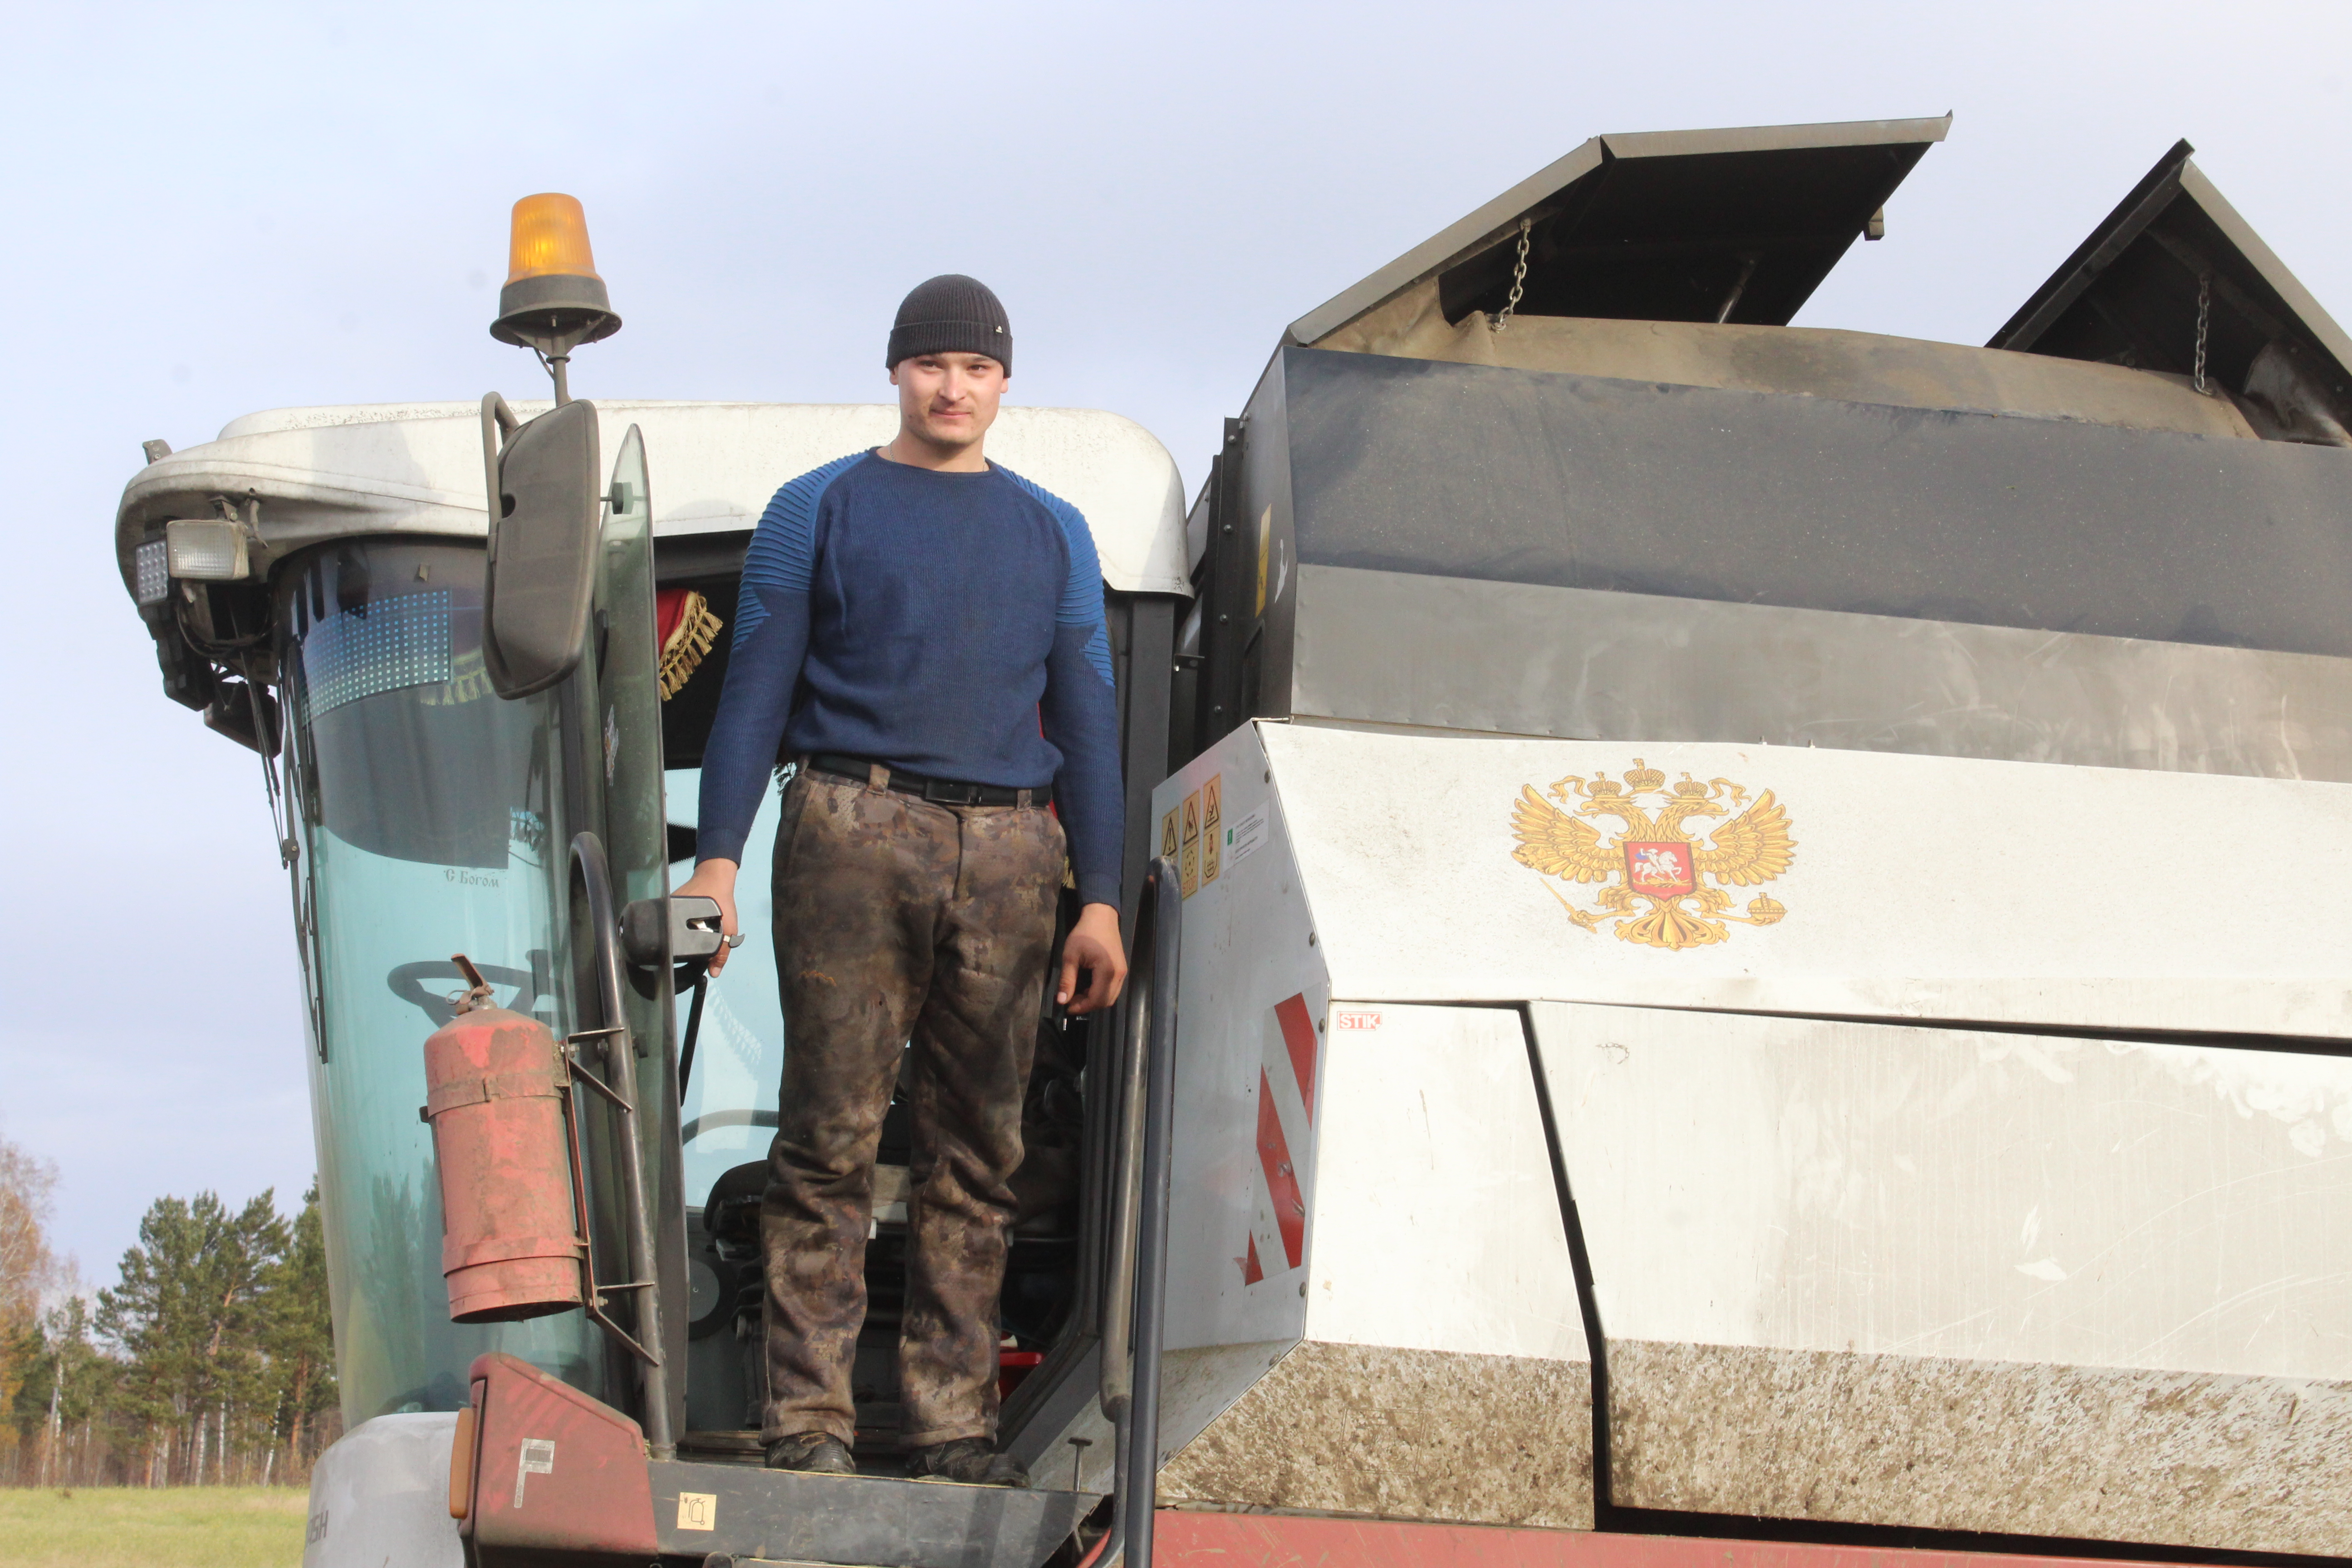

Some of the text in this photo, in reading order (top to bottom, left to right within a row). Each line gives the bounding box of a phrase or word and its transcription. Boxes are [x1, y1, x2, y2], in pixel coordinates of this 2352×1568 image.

[446, 868, 500, 887] С Богом
[1340, 1014, 1379, 1028] STIK
